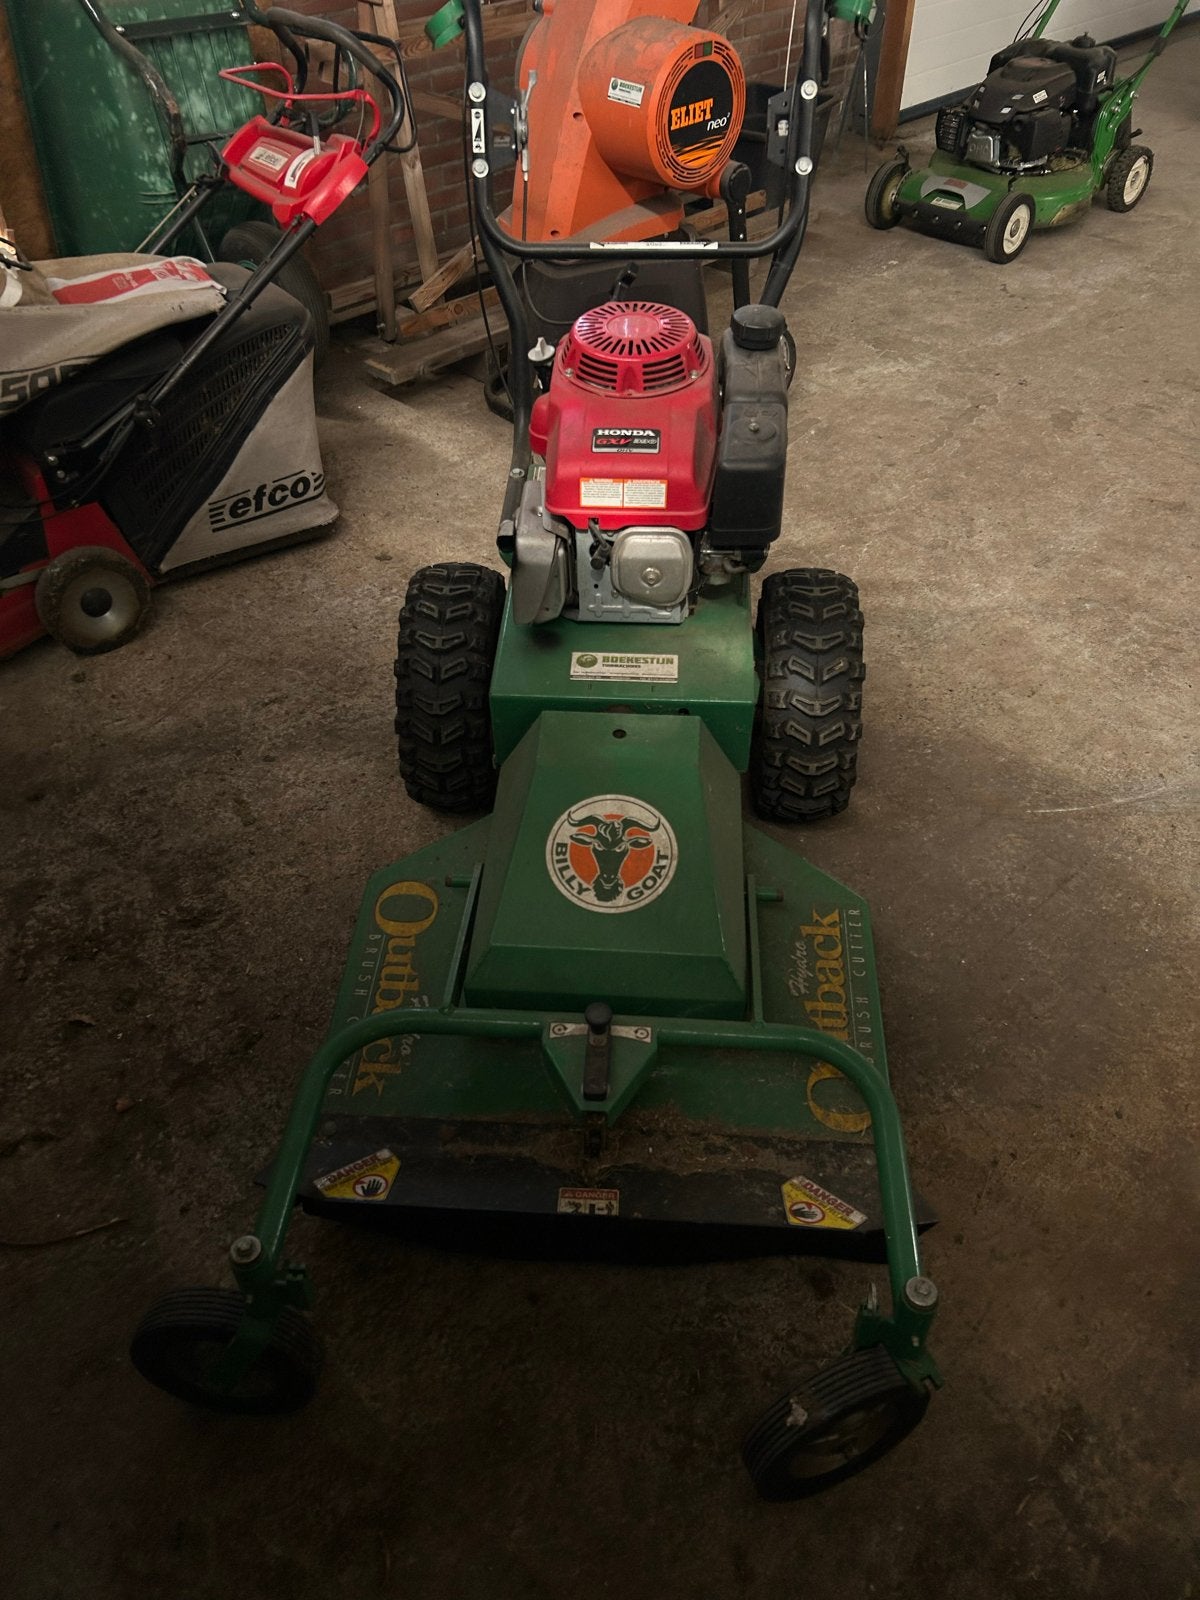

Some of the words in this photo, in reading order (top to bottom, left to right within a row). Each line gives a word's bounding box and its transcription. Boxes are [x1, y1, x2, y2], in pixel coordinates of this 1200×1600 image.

[671, 98, 713, 131] ELIET
[229, 477, 311, 519] efco
[555, 842, 591, 896] BILLY
[626, 849, 669, 901] GOAT
[354, 934, 381, 996] BRUSH
[788, 940, 813, 997] Hydro
[848, 908, 866, 977] CUTTER
[352, 880, 439, 1097] Outbck
[803, 1182, 853, 1217] DANGER
